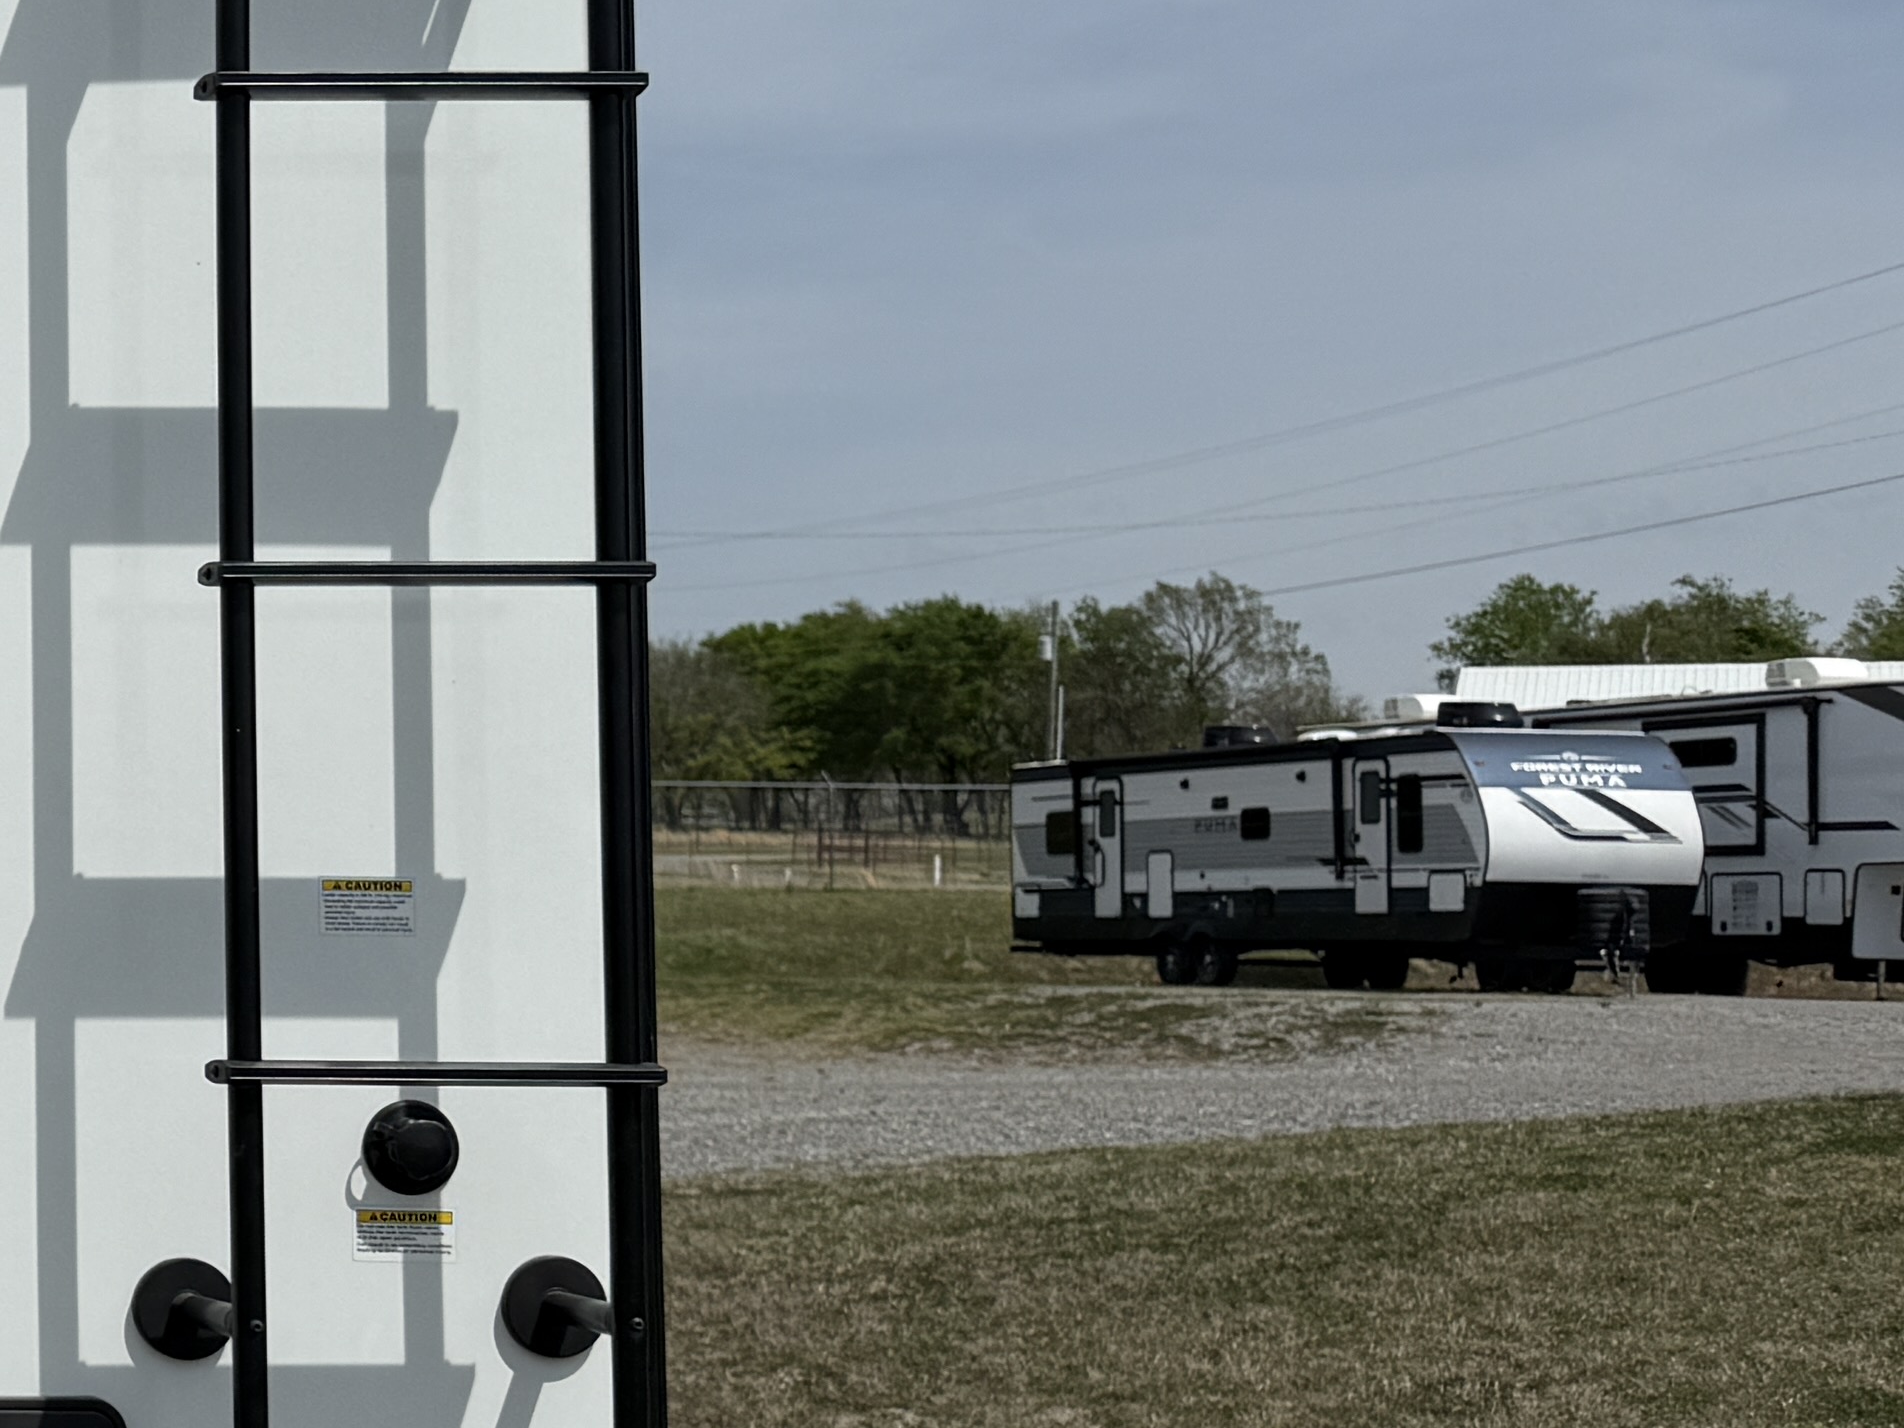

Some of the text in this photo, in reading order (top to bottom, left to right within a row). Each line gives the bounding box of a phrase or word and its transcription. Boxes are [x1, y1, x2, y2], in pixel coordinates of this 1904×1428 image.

[1509, 761, 1642, 774] FOREST RIVER
[1539, 774, 1627, 788] PUMA
[344, 880, 403, 891] CAUTION
[379, 1212, 438, 1223] CAUTION
